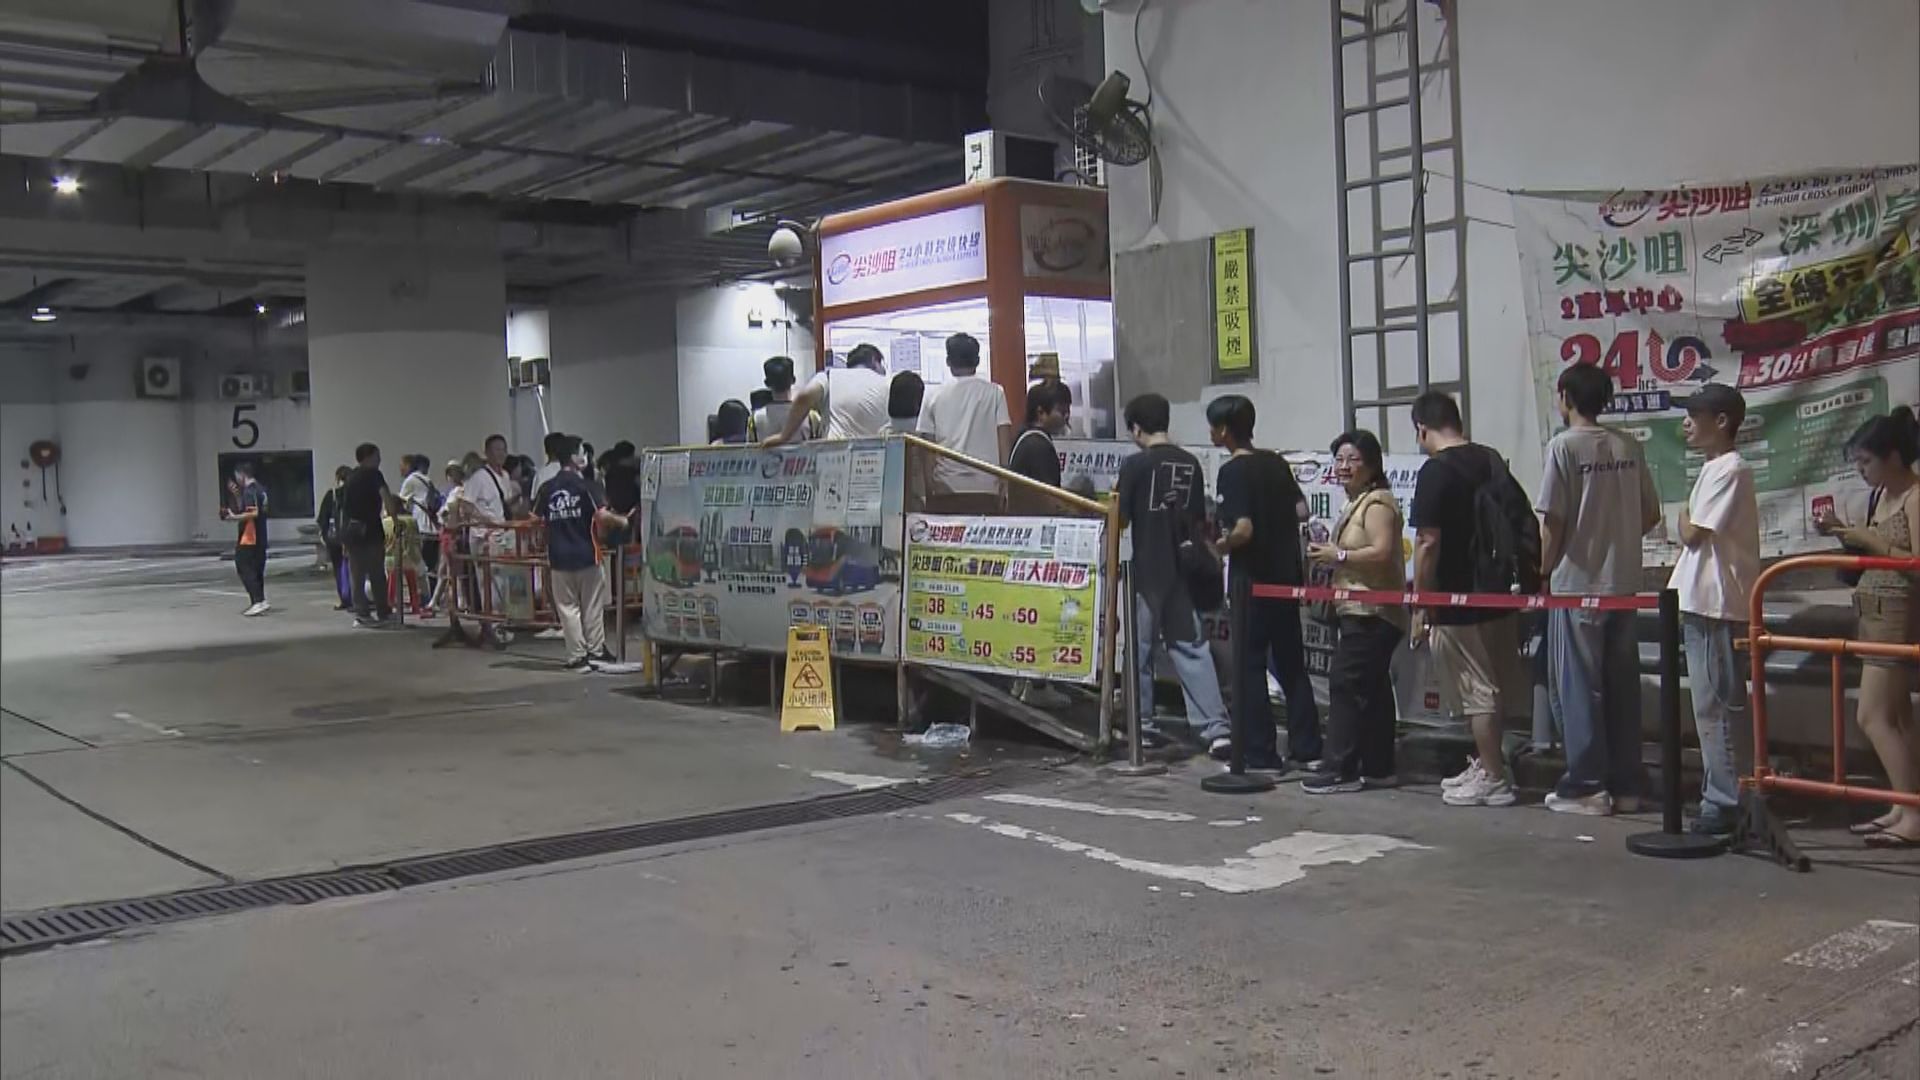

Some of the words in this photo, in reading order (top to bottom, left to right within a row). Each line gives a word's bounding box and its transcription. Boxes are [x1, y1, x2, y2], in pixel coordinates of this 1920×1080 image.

[1656, 184, 1752, 222] 尖沙咀
[852, 249, 897, 279] 尖沙咀
[1553, 230, 1688, 285] 尖沙咀
[1223, 258, 1243, 356] 嚴禁吸煙
[231, 404, 260, 449] 5
[928, 525, 966, 543] 尖沙咀
[1052, 646, 1082, 665] $25
